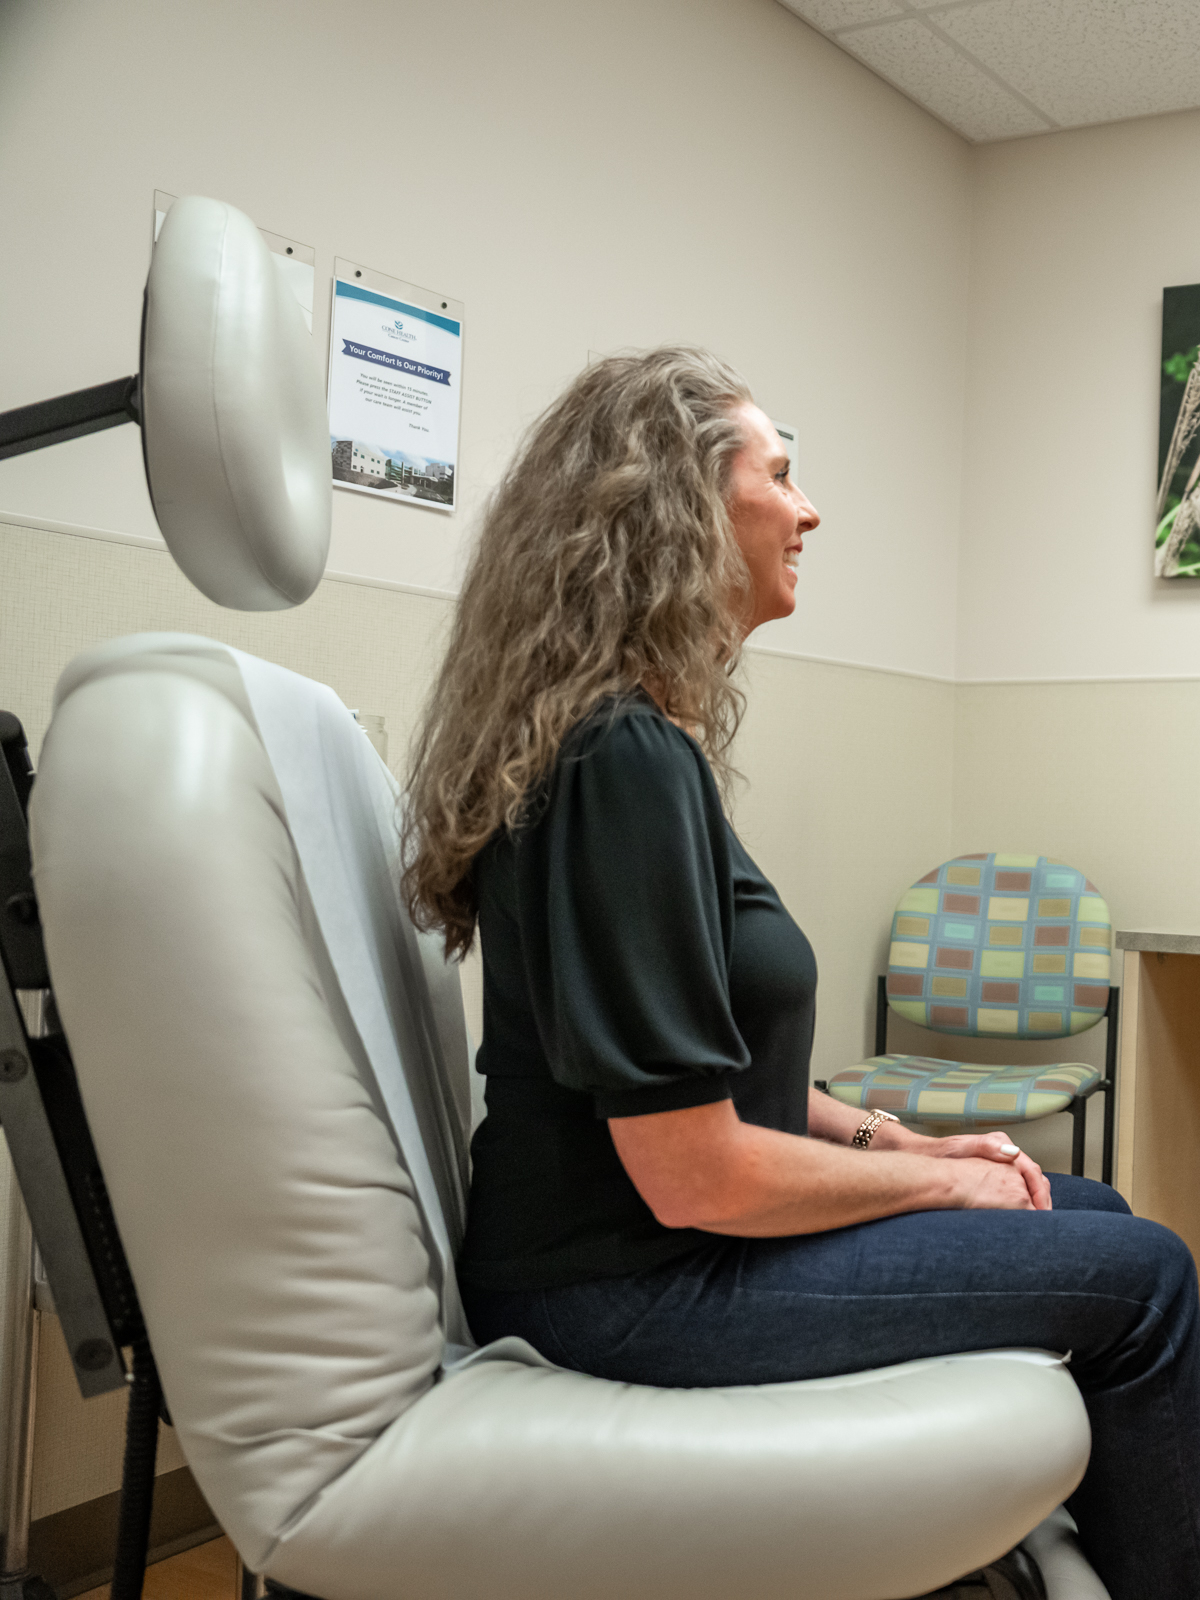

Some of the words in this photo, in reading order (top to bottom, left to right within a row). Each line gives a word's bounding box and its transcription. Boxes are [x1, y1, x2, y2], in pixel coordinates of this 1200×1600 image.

[349, 344, 366, 356] Your
[367, 350, 396, 365] Comfort
[396, 359, 402, 367] Is
[403, 361, 416, 371] Our
[417, 365, 444, 380] Priority!
[407, 401, 423, 409] member
